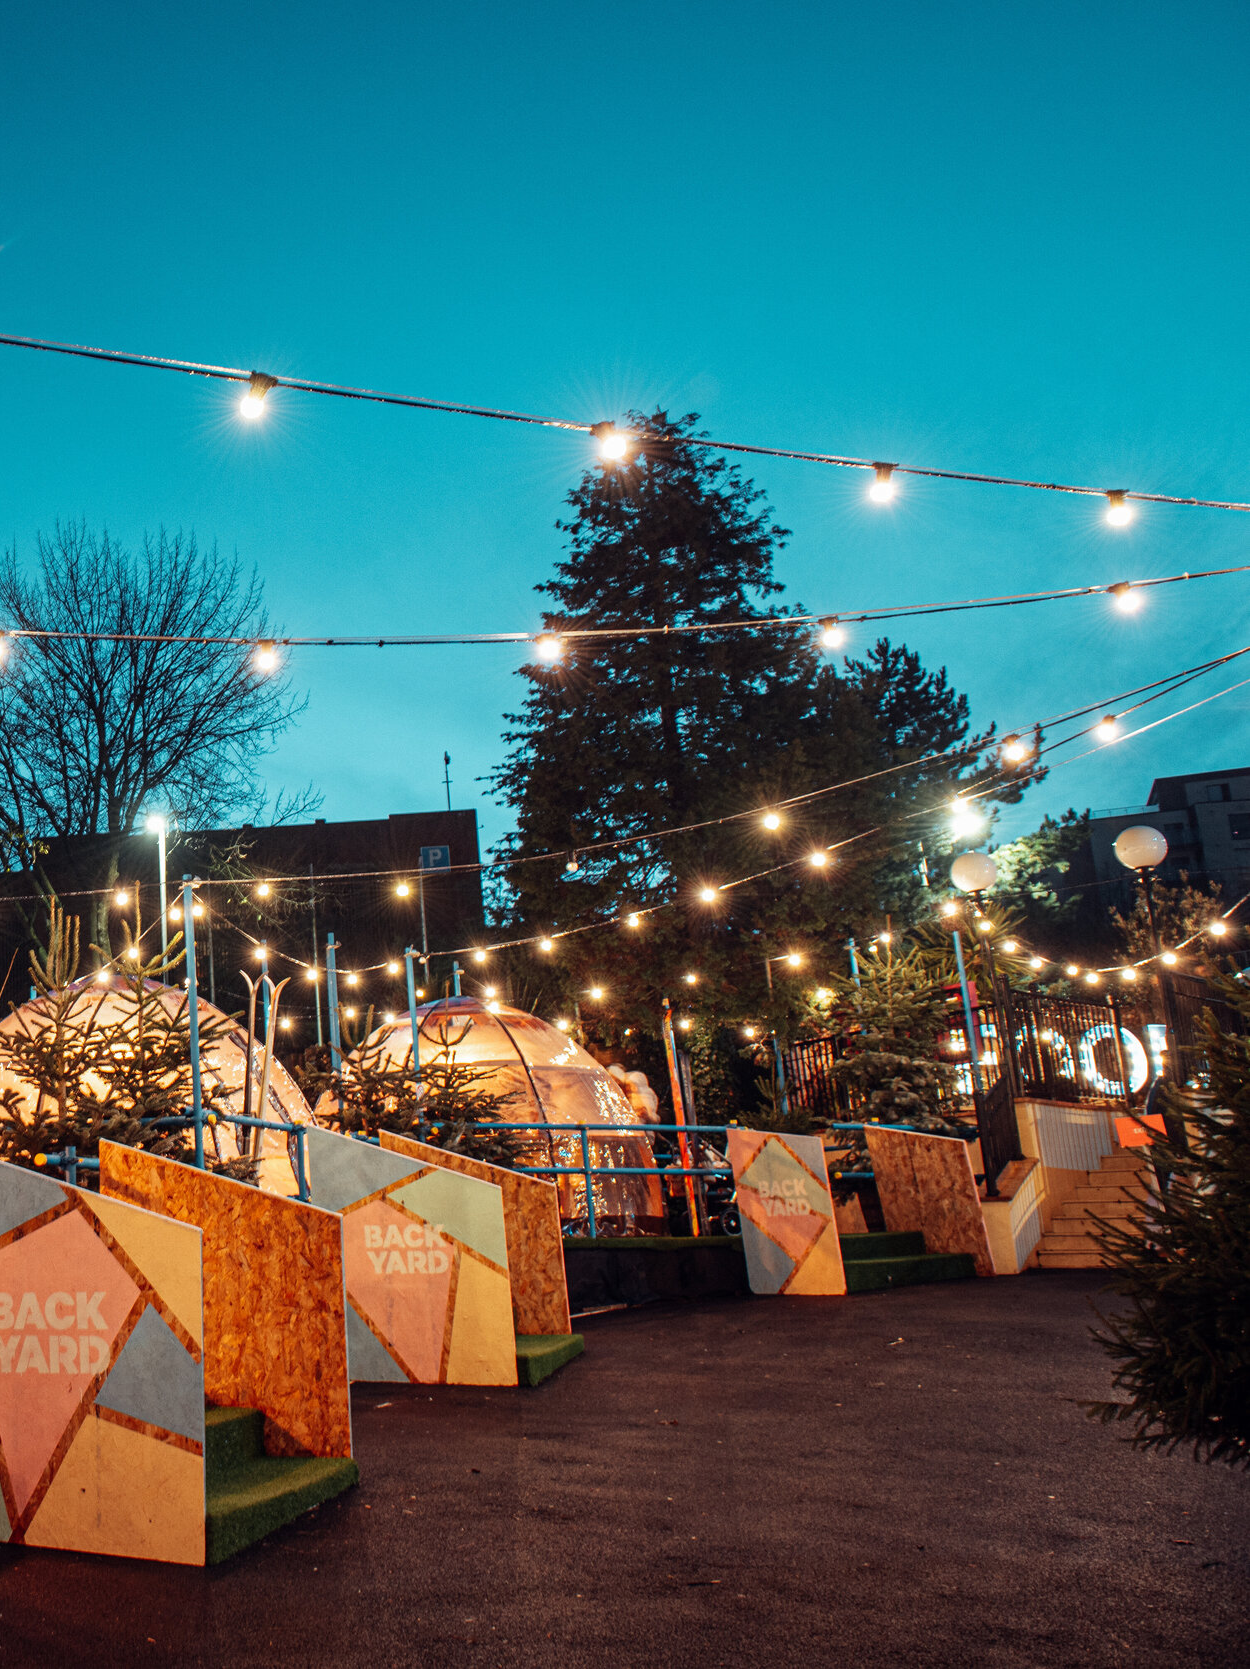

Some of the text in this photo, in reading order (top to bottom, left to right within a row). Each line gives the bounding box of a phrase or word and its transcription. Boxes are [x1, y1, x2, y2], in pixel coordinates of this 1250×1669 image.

[429, 849, 442, 867] P
[758, 1179, 807, 1198] BACK
[761, 1198, 810, 1216] YARD
[363, 1224, 446, 1248] BACK
[367, 1250, 449, 1275] YARD
